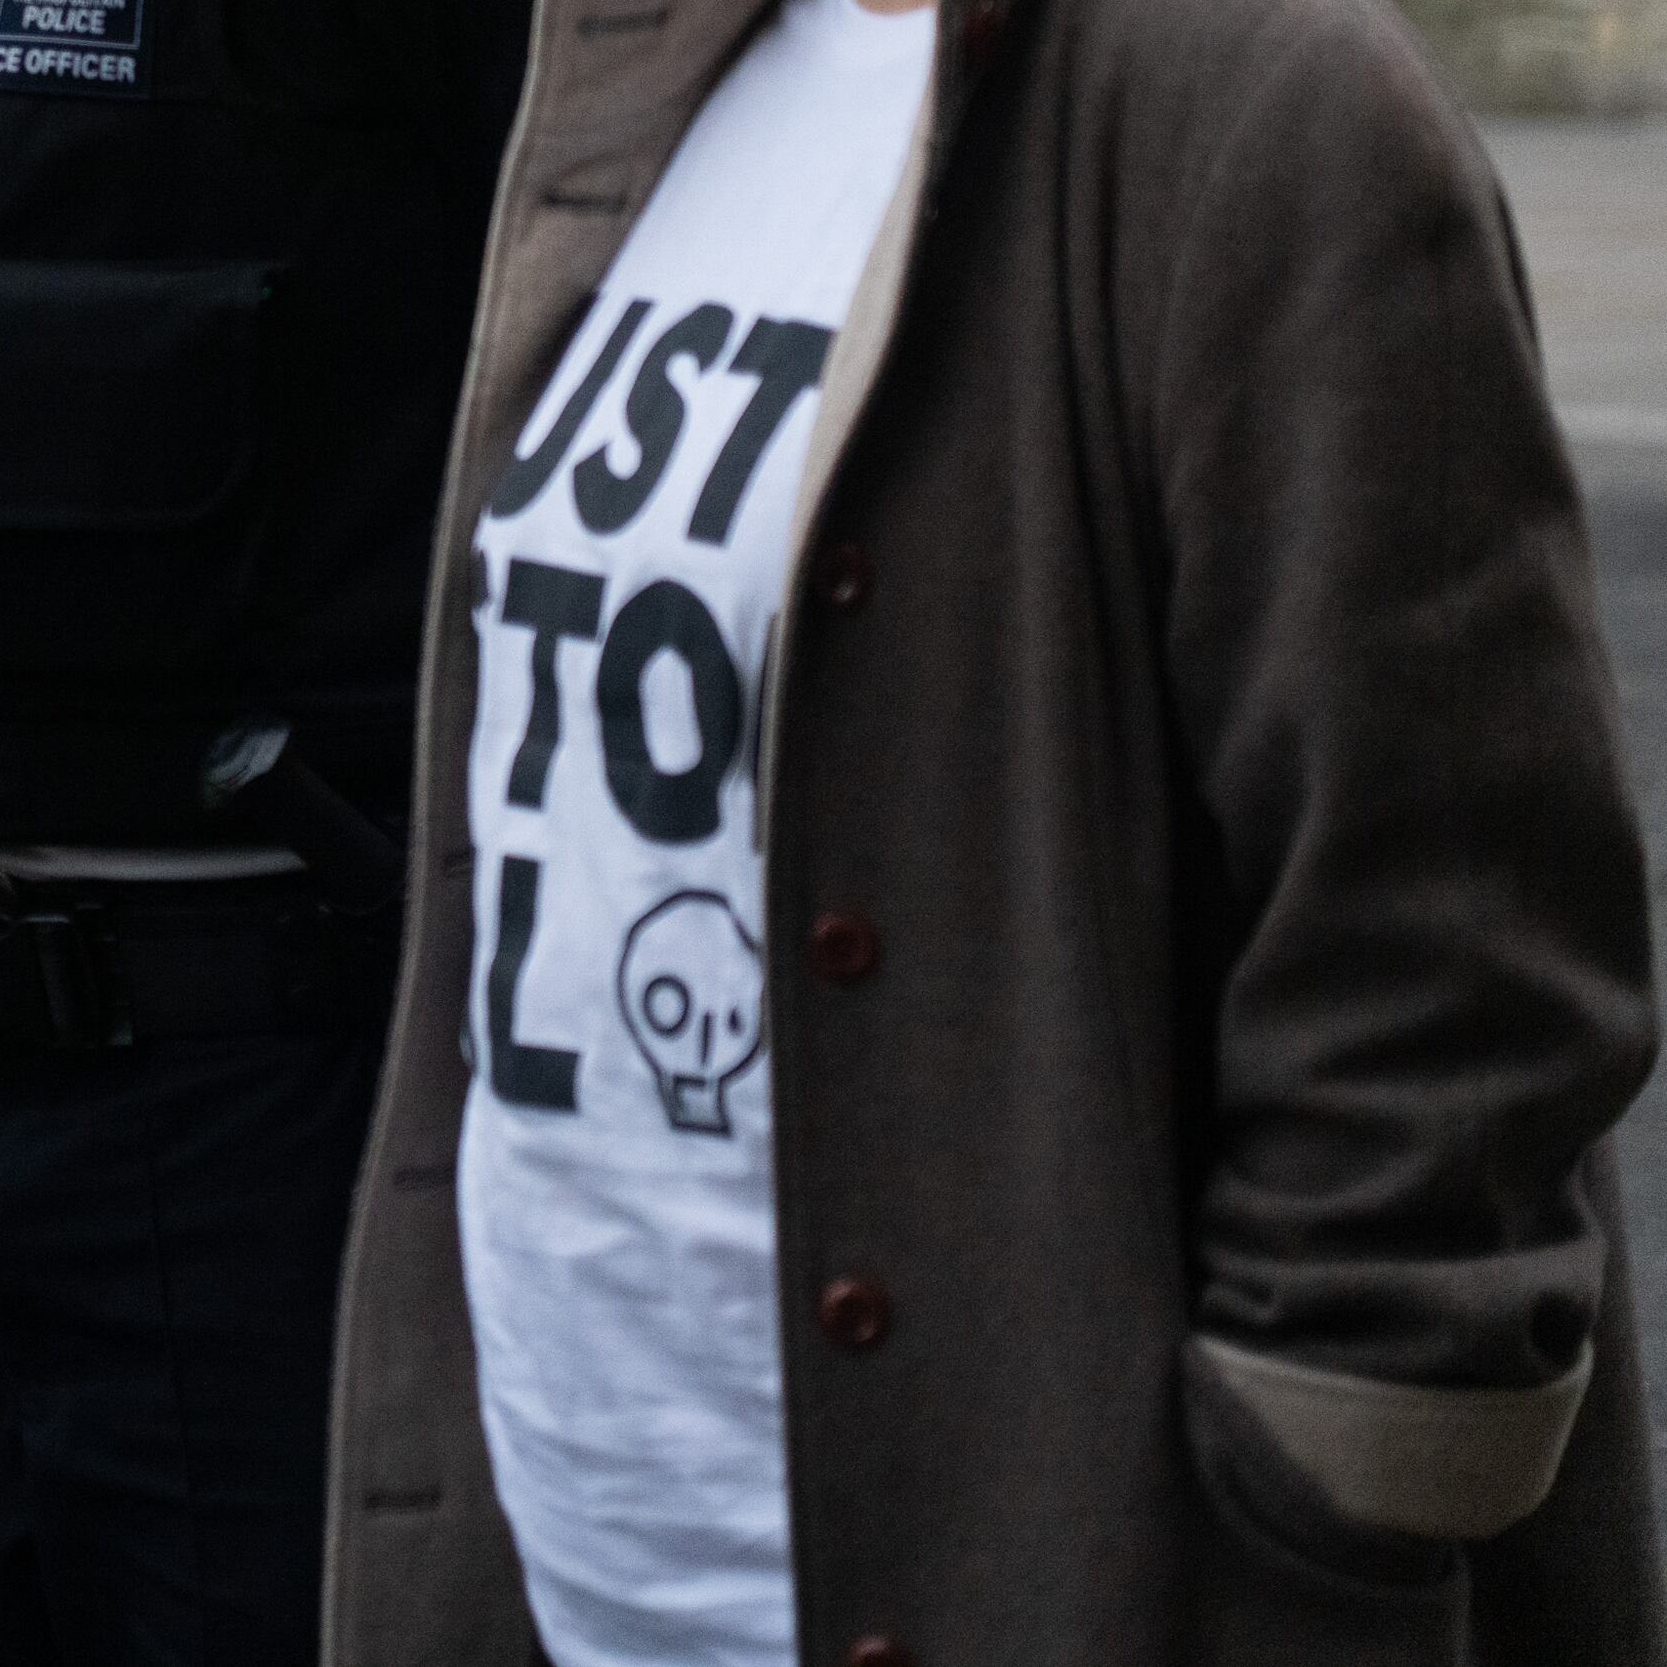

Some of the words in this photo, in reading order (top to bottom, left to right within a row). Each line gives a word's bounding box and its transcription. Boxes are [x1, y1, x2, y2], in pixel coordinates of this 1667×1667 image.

[22, 4, 107, 34] POLICE
[24, 48, 137, 83] OFFICER
[489, 296, 838, 548] UST
[470, 547, 743, 847] TO
